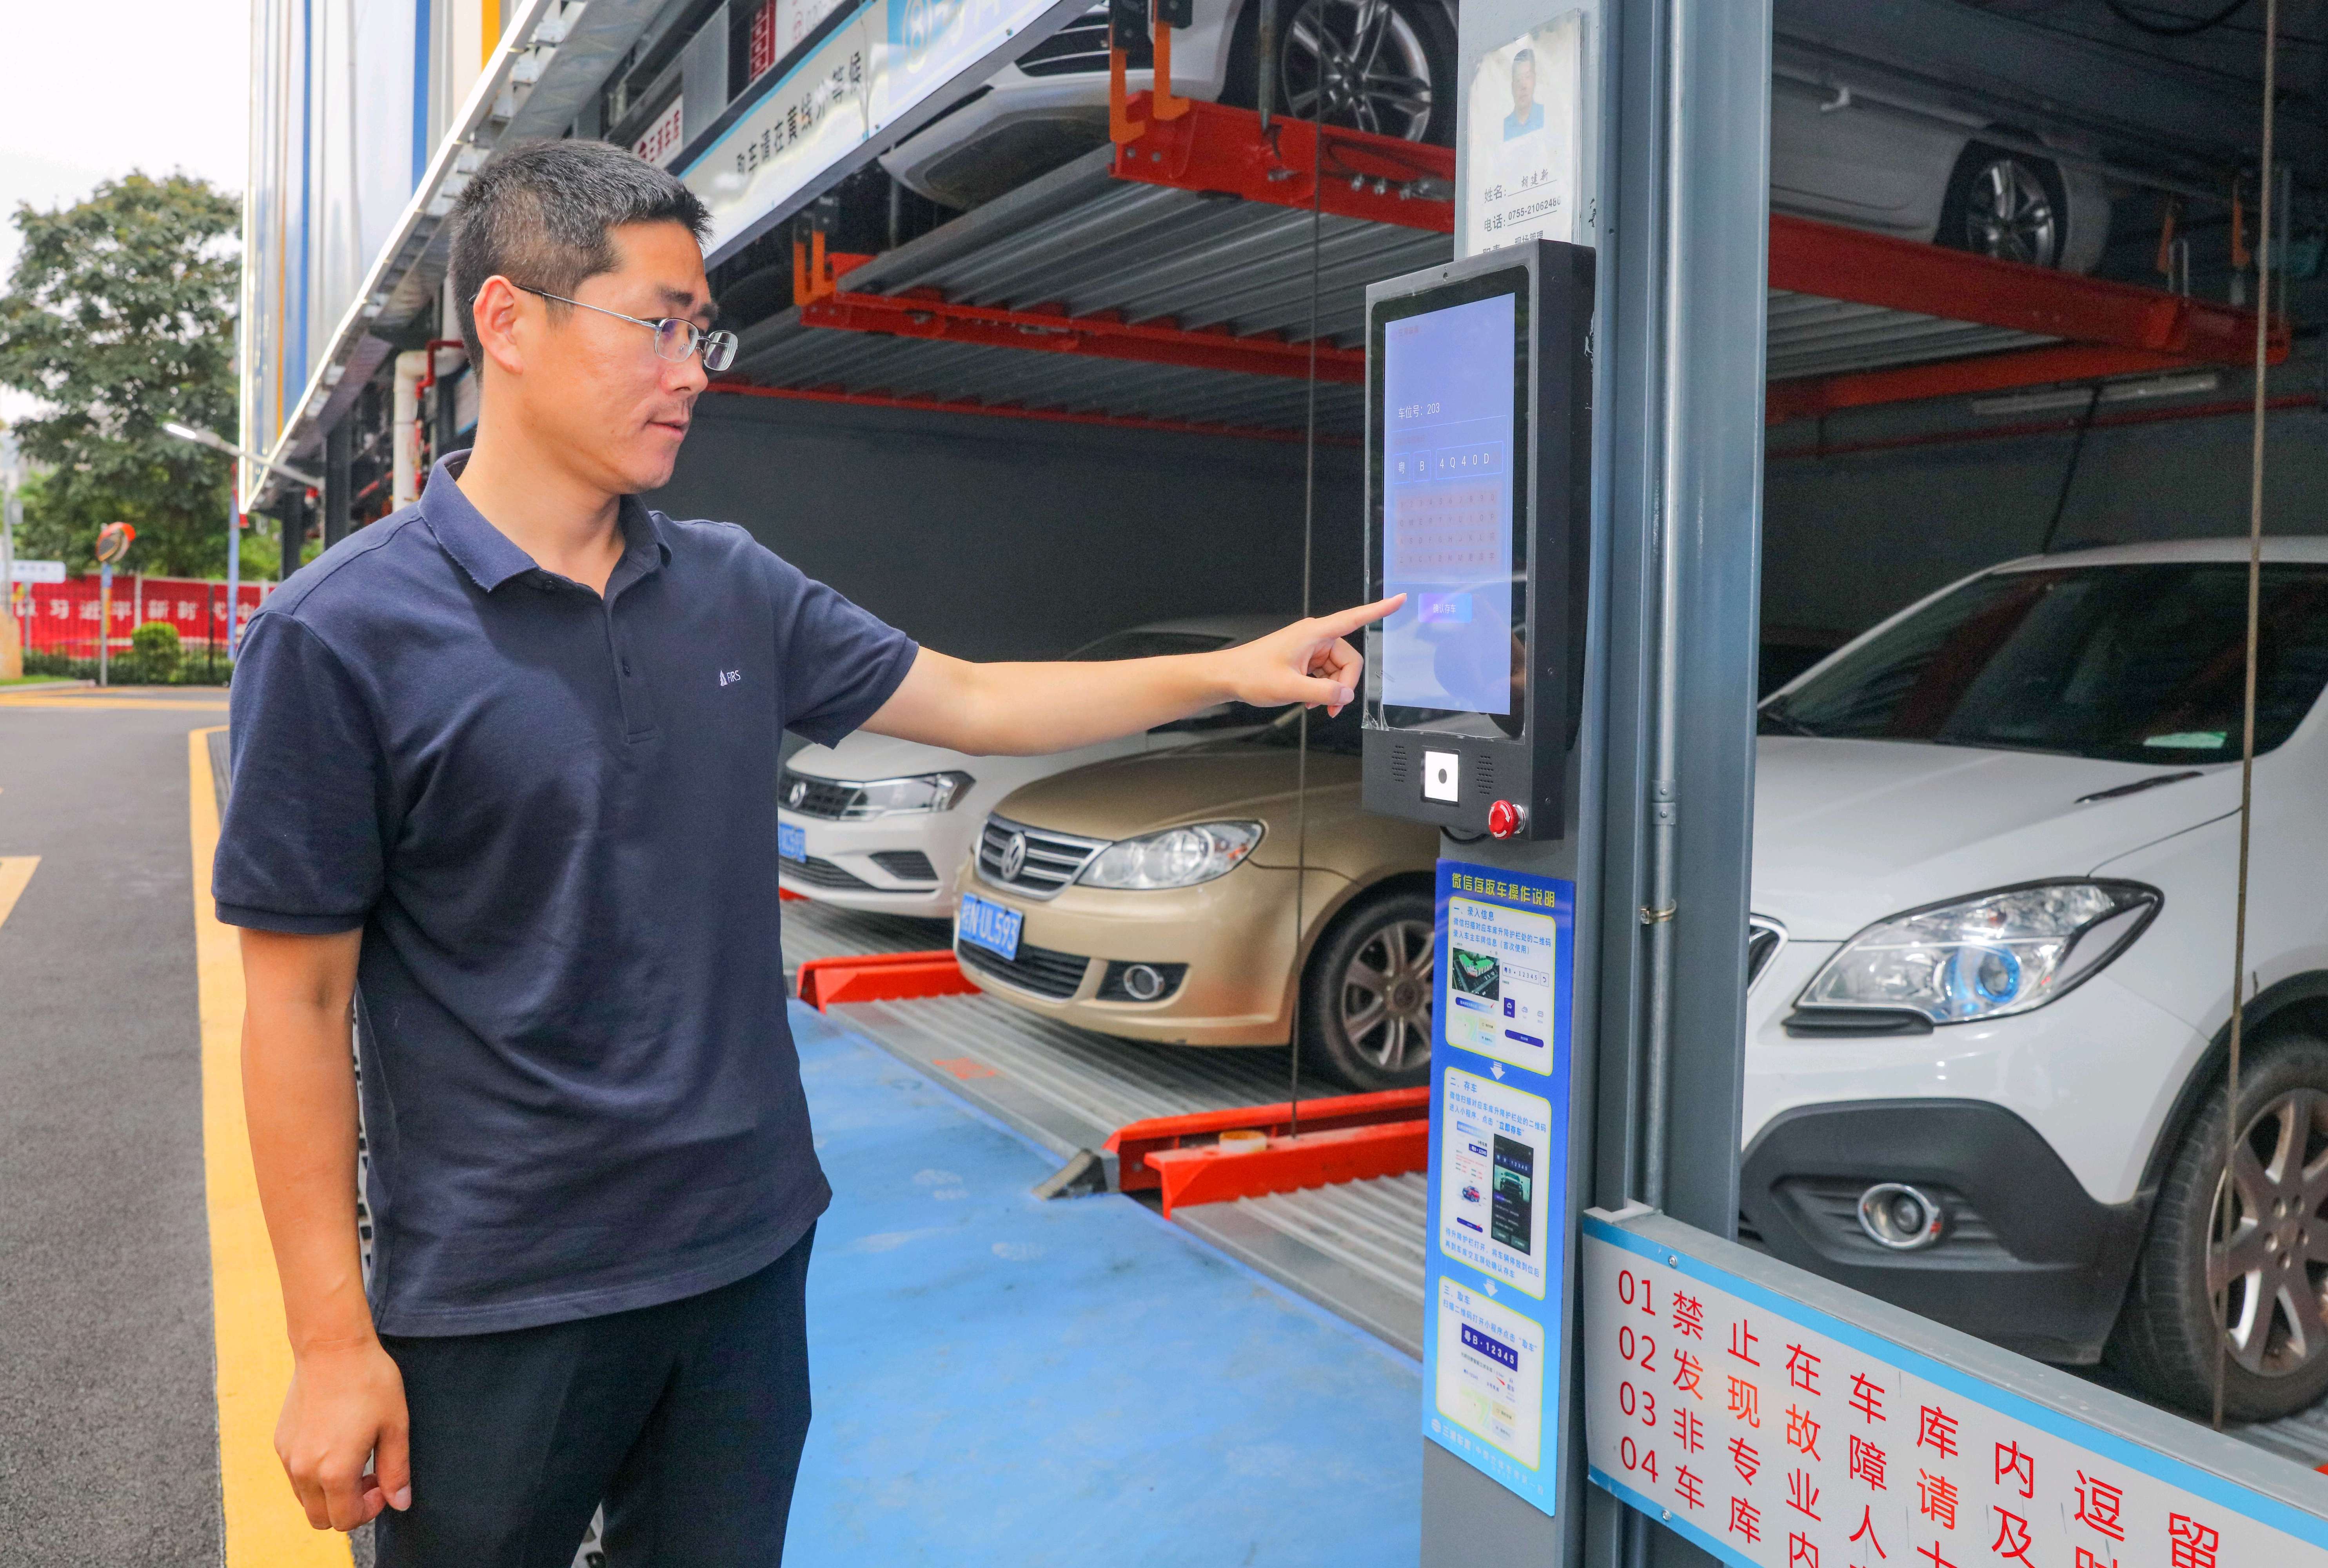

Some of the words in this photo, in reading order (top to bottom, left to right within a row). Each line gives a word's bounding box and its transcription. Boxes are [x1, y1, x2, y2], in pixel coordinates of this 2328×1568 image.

[1484, 184, 1506, 203] 姓名：
[1484, 214, 1506, 232] 电话：
[1433, 604, 1456, 615] 确认存车
[726, 670, 741, 683] FIRS
[1452, 873, 1555, 908] 微信存取车操作说明
[1618, 1325, 1656, 1373] 02
[1618, 1270, 1656, 1316] 01
[1672, 1290, 2219, 1568] 禁止在车库内逗留
[1619, 1381, 1656, 1426] 03
[1620, 1436, 1659, 1484] 04
[1674, 1464, 1867, 1568] 车库内
